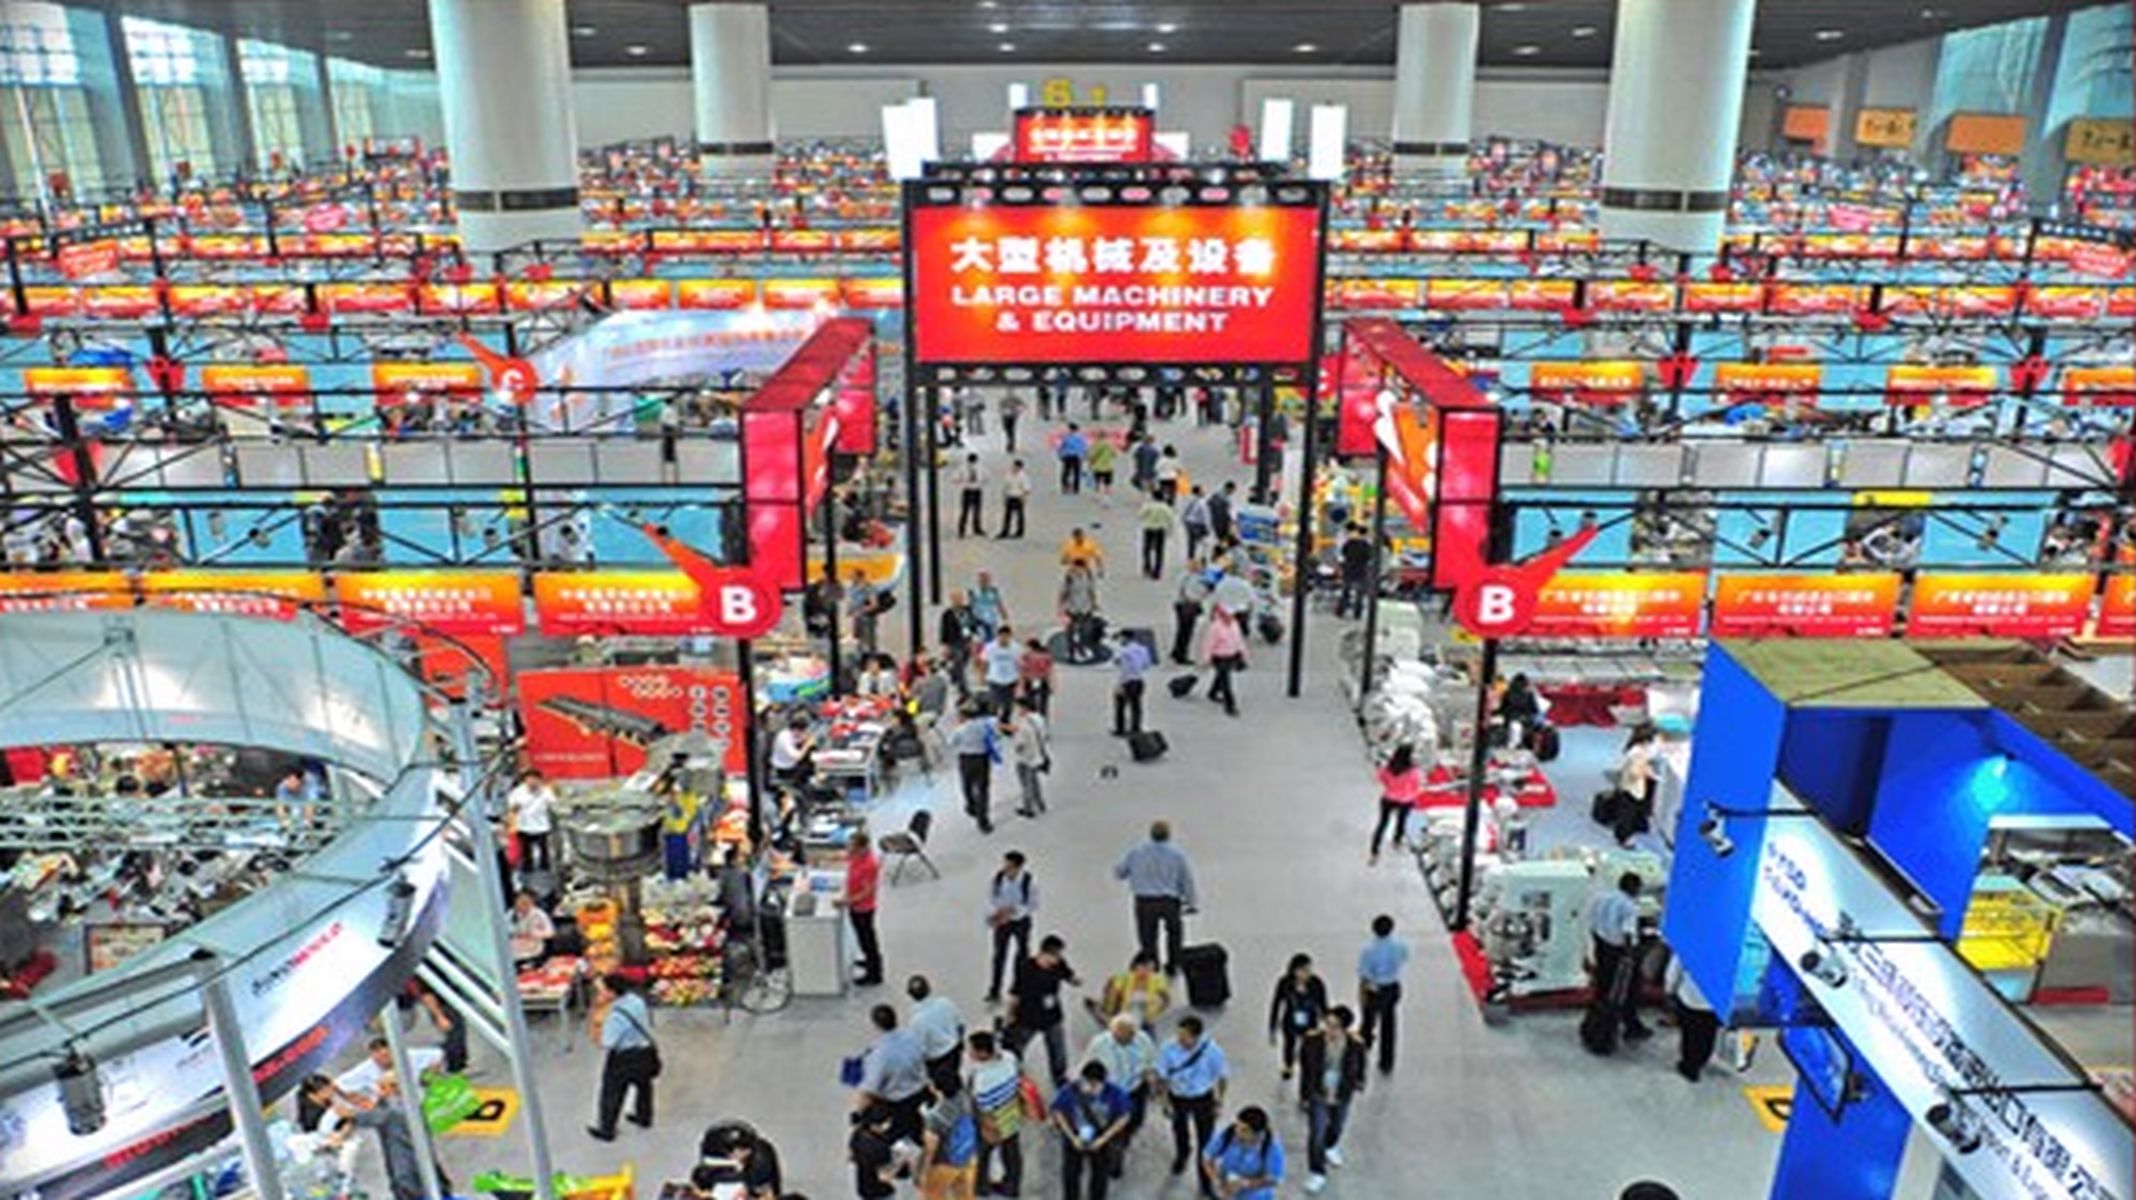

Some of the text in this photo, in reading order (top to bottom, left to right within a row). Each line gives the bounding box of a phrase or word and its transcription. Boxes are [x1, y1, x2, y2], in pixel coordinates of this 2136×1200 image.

[951, 236, 1275, 276] 大型机械及设备
[952, 285, 1273, 307] LARGE MACHINERY
[997, 311, 1229, 332] & EQUIPMENT
[721, 586, 757, 624] B
[1478, 585, 1515, 624] B
